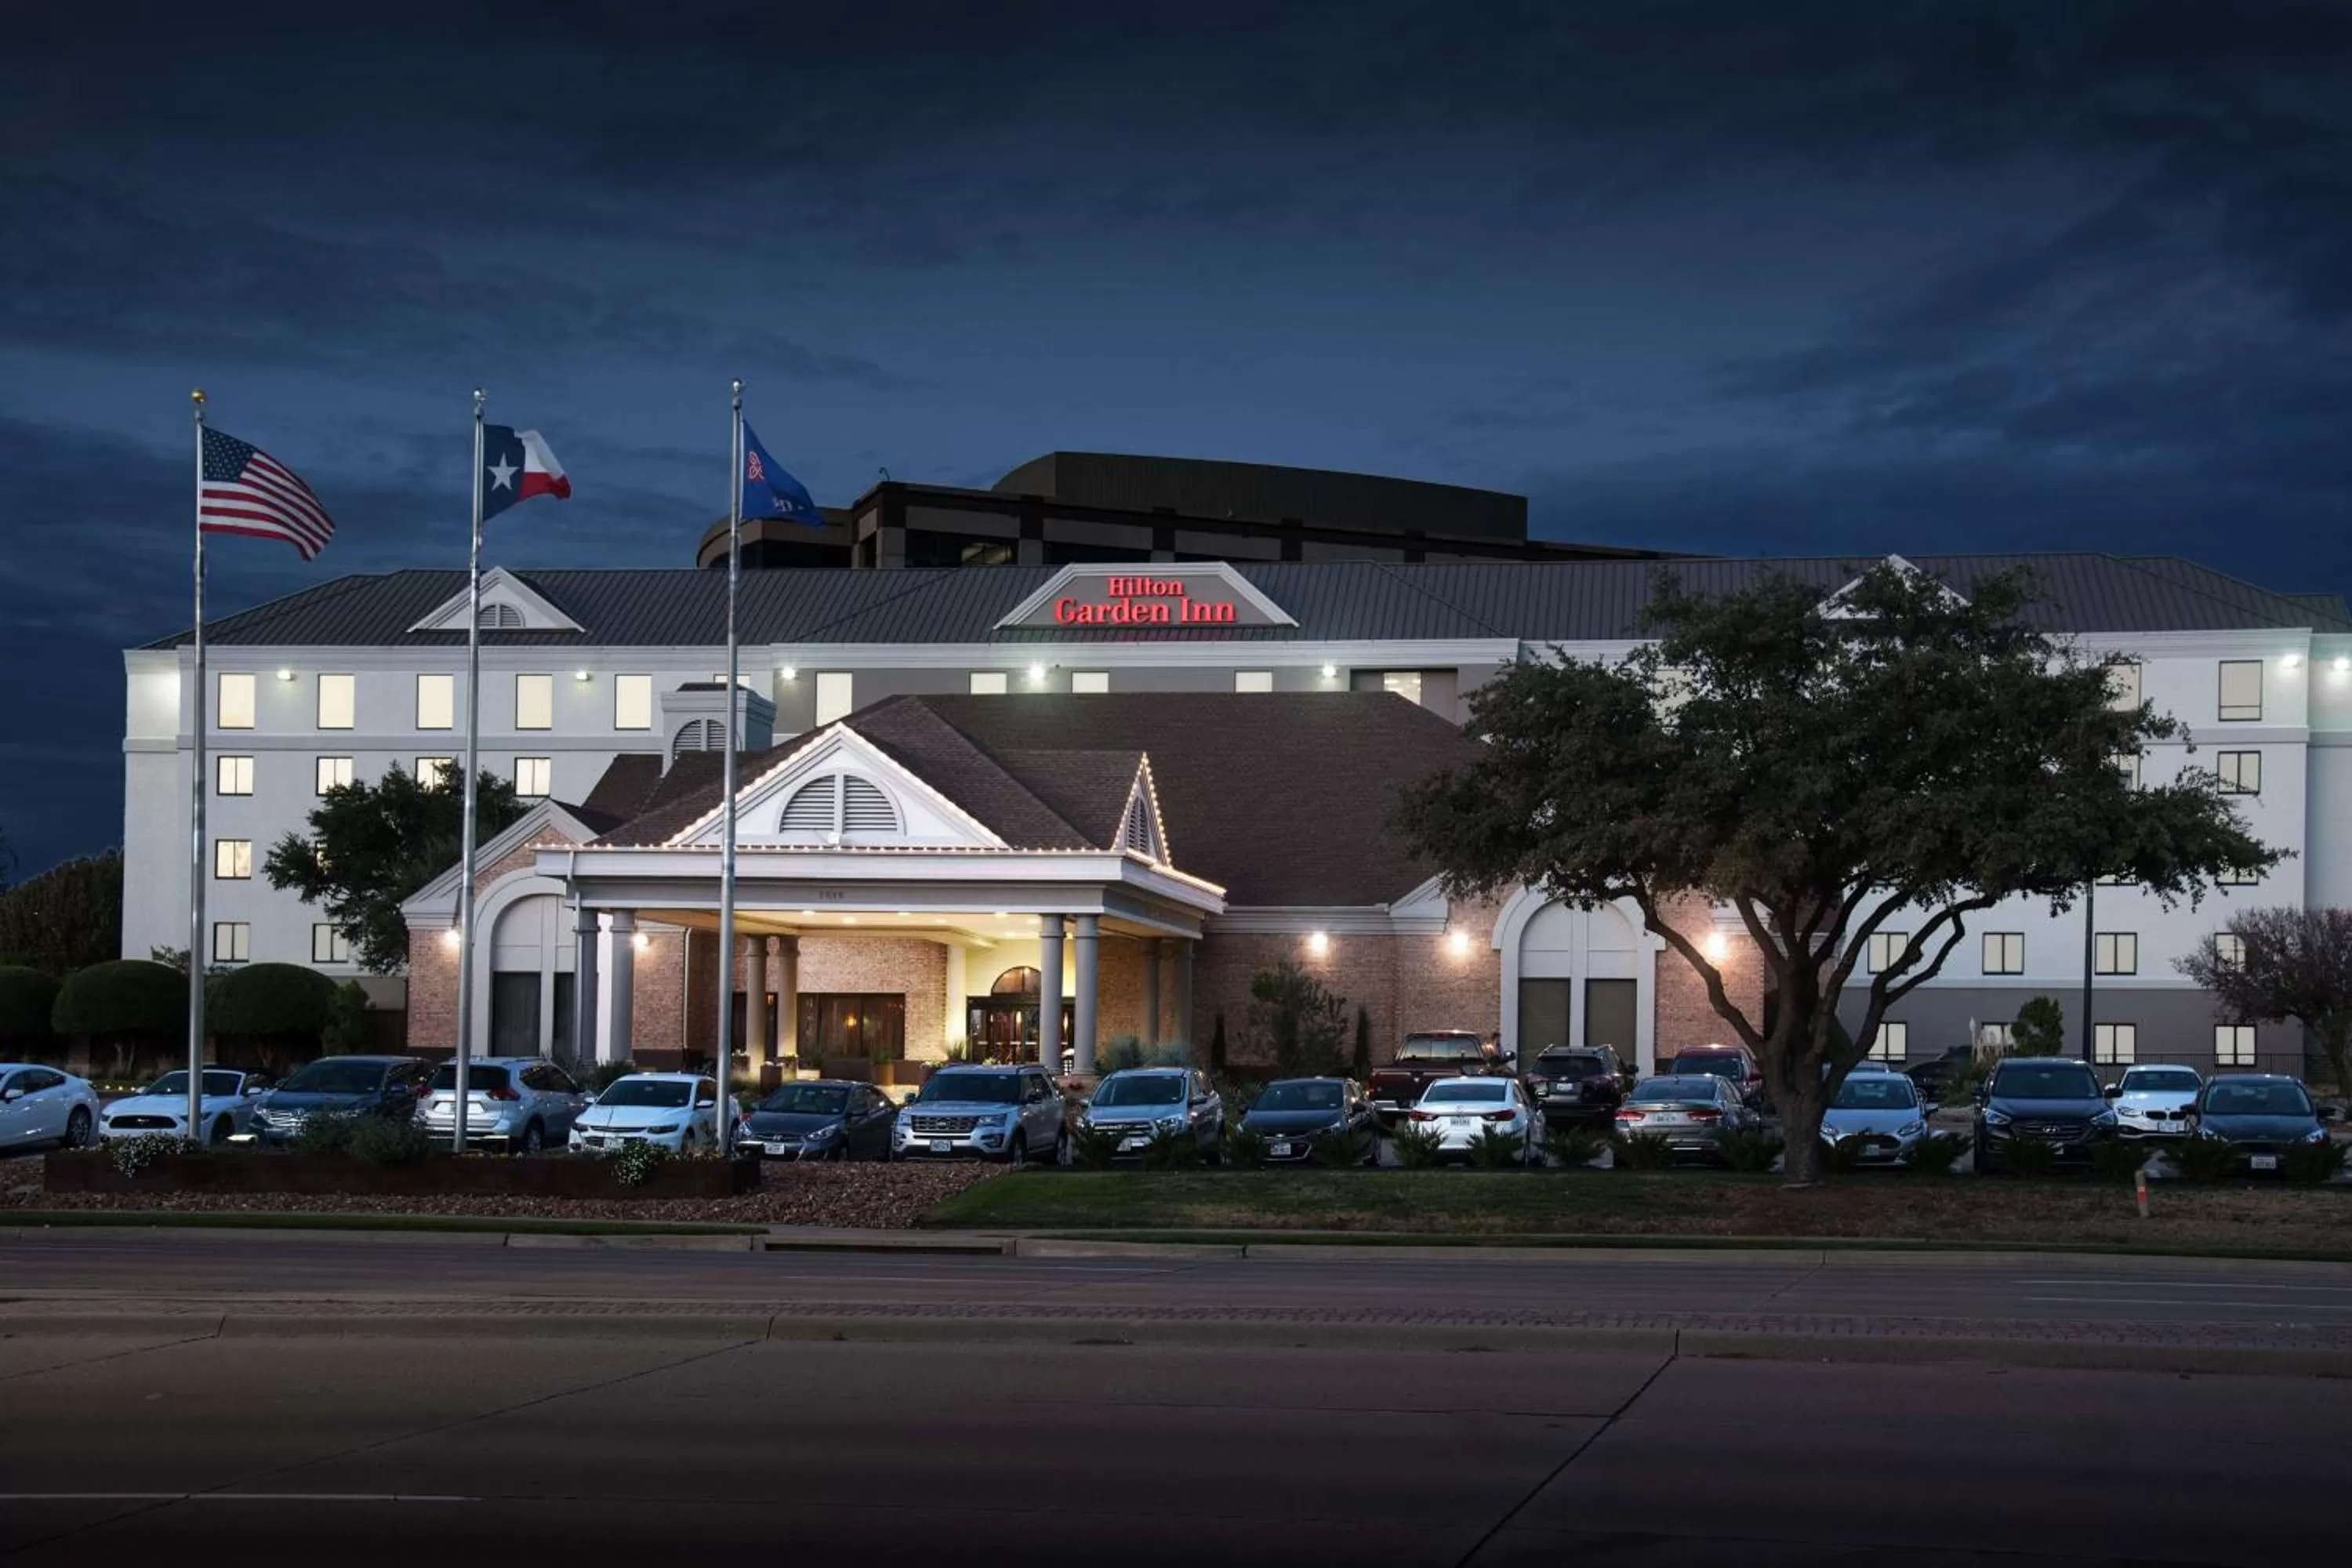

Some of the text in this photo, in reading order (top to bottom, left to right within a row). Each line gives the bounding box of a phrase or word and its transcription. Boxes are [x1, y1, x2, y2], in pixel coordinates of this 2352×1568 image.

[1108, 576, 1185, 597] Hilton
[1054, 597, 1237, 625] Garden Inn
